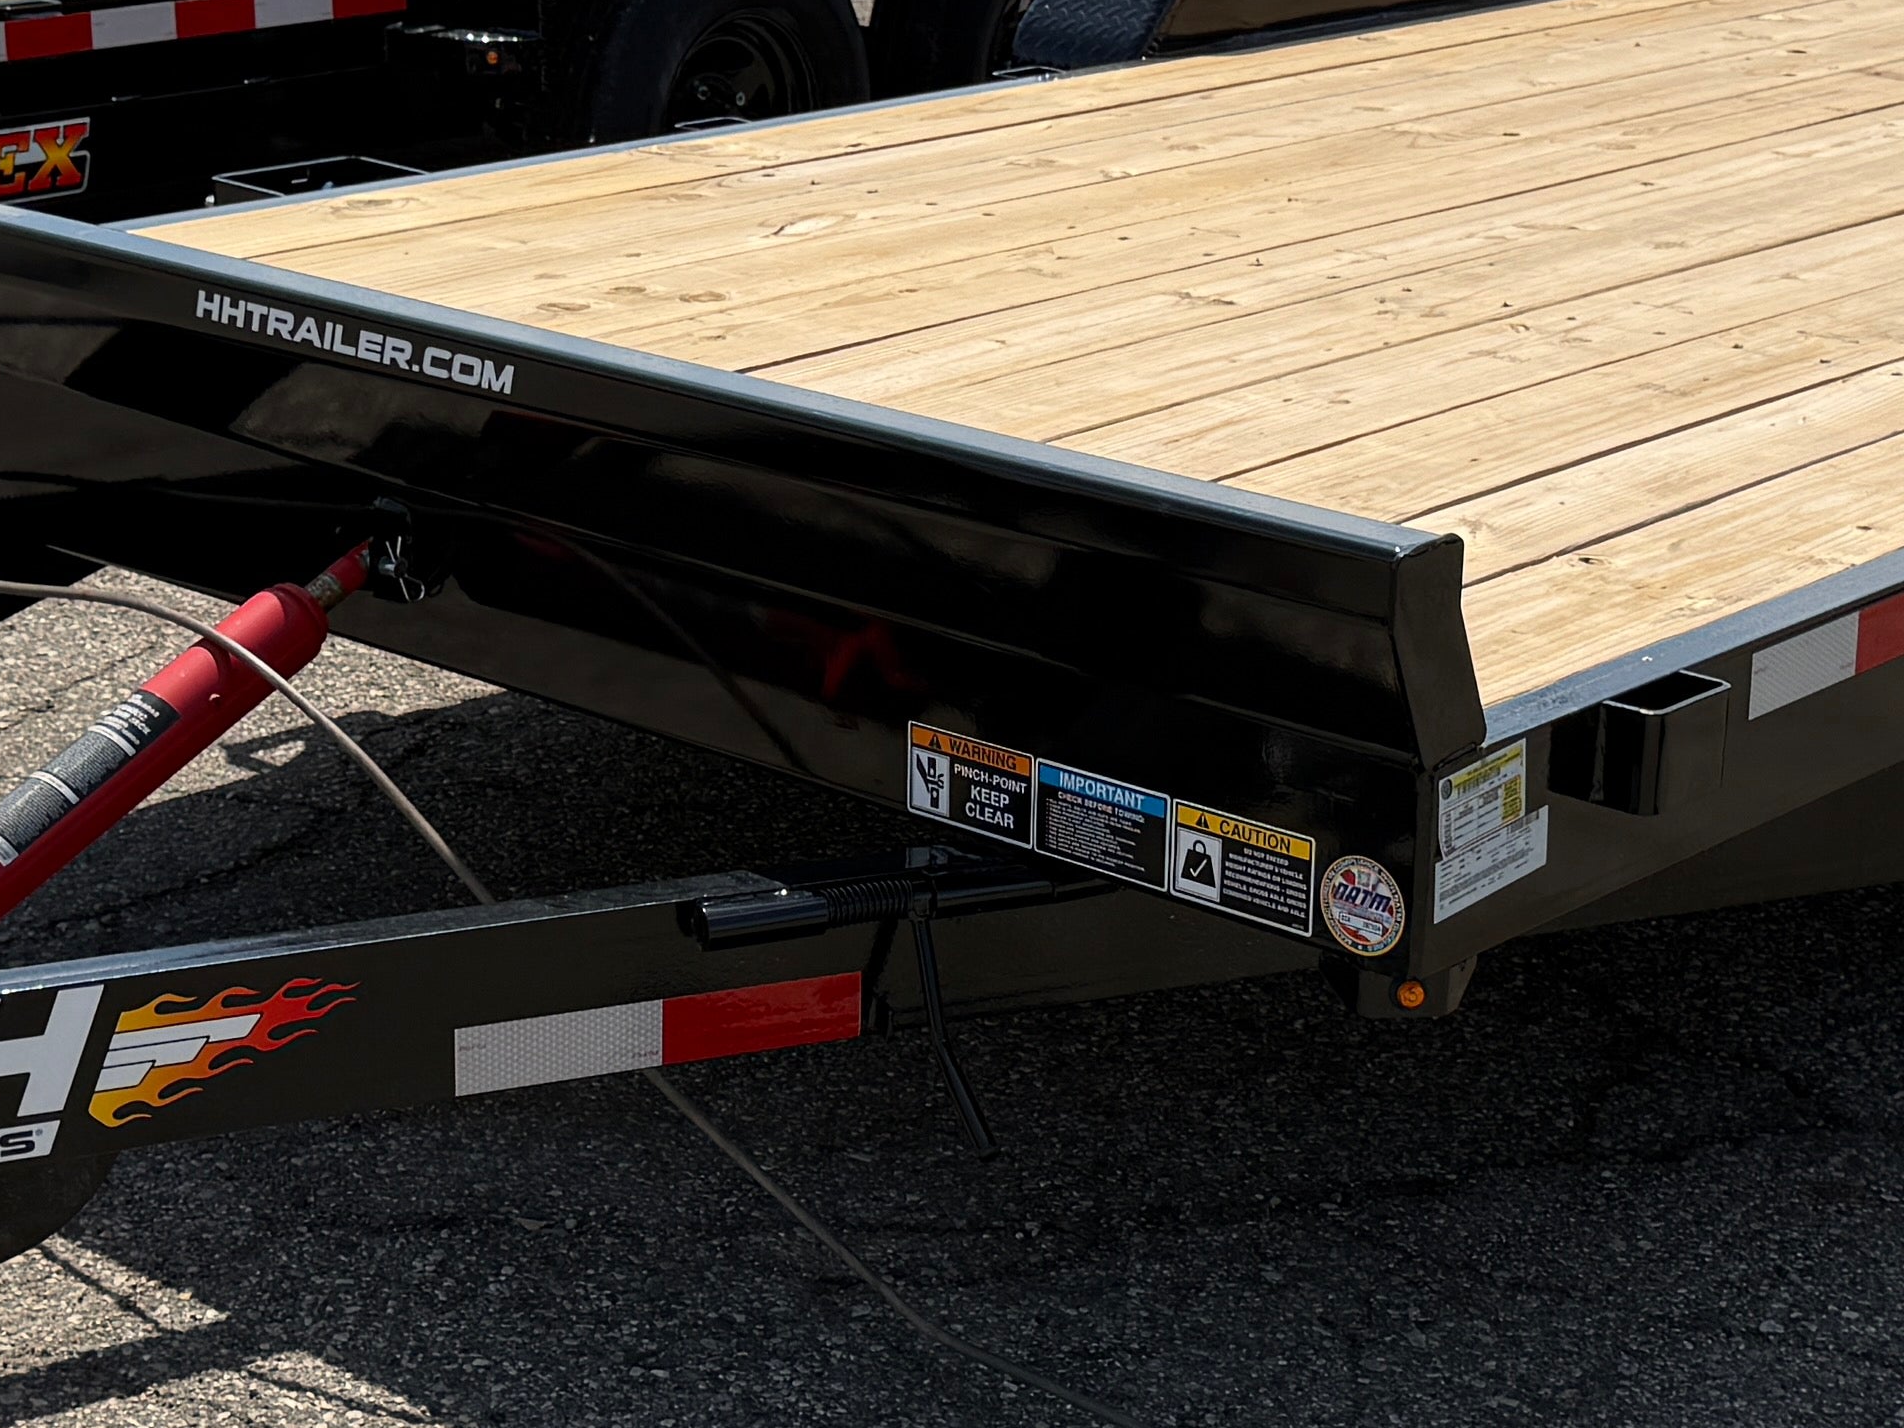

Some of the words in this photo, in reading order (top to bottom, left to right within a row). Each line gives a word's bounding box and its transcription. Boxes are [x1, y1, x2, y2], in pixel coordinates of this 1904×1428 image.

[196, 289, 515, 395] HHTRAILER.COM
[948, 738, 1017, 770] WARNING
[954, 763, 1027, 794] PINCH-POINT
[1059, 771, 1145, 810] IMPORTANT
[971, 785, 1010, 808] KEEP
[1058, 791, 1083, 805] CHECK
[1084, 798, 1113, 814] BEFORE
[965, 802, 1015, 829] CLEAR
[1219, 819, 1291, 853] CAUTION
[1336, 883, 1392, 913] NATM
